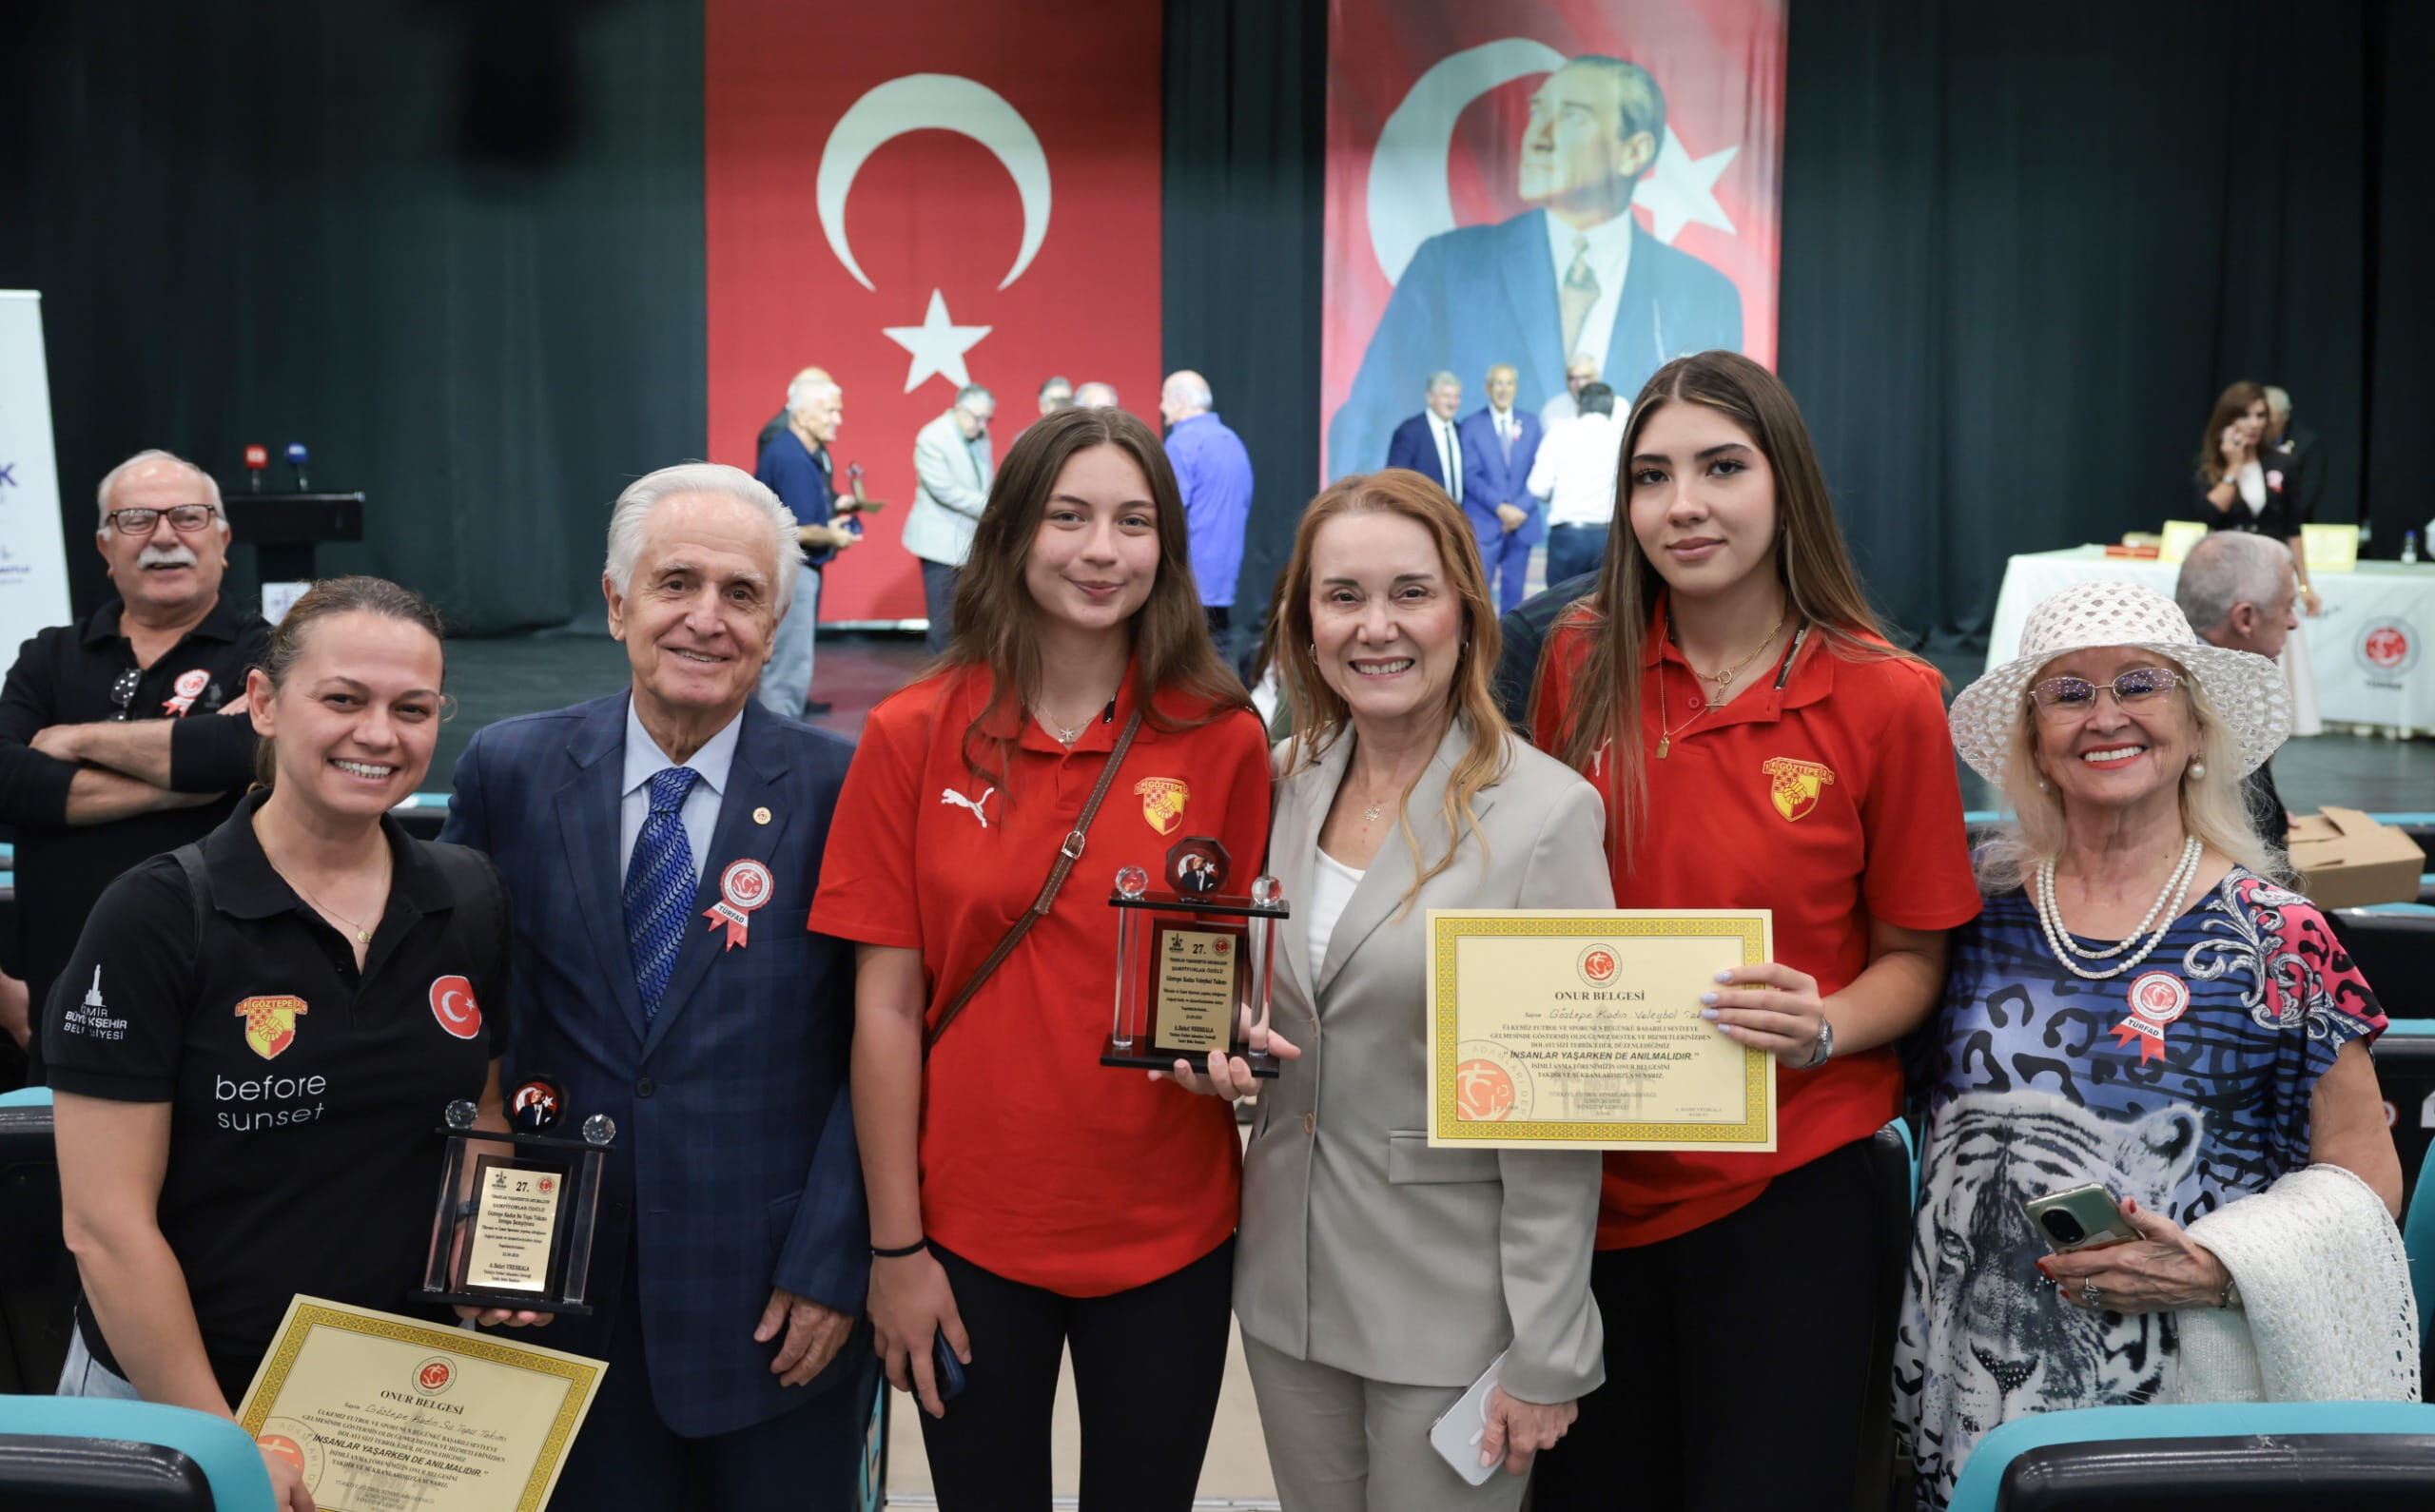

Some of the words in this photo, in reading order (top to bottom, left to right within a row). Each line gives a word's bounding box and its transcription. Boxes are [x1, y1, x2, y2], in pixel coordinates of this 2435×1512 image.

[718, 904, 745, 923] TÜRFAD
[1554, 991, 1590, 1000] ONUR
[1593, 990, 1645, 1000] BELGESİ
[2128, 1018, 2159, 1037] TÜRFAD
[1510, 1050, 1559, 1059] İNSANLAR
[1561, 1051, 1612, 1060] YAŞARKEN
[1615, 1052, 1629, 1060] DE
[215, 1074, 327, 1101] before
[217, 1102, 324, 1132] sunset
[516, 1180, 530, 1192] 27.
[380, 1390, 414, 1405] ONUR
[416, 1397, 465, 1415] BELGESİ
[313, 1433, 361, 1450] İNSANLAR
[361, 1444, 411, 1462] YAŞARKEN
[411, 1455, 424, 1464] DE
